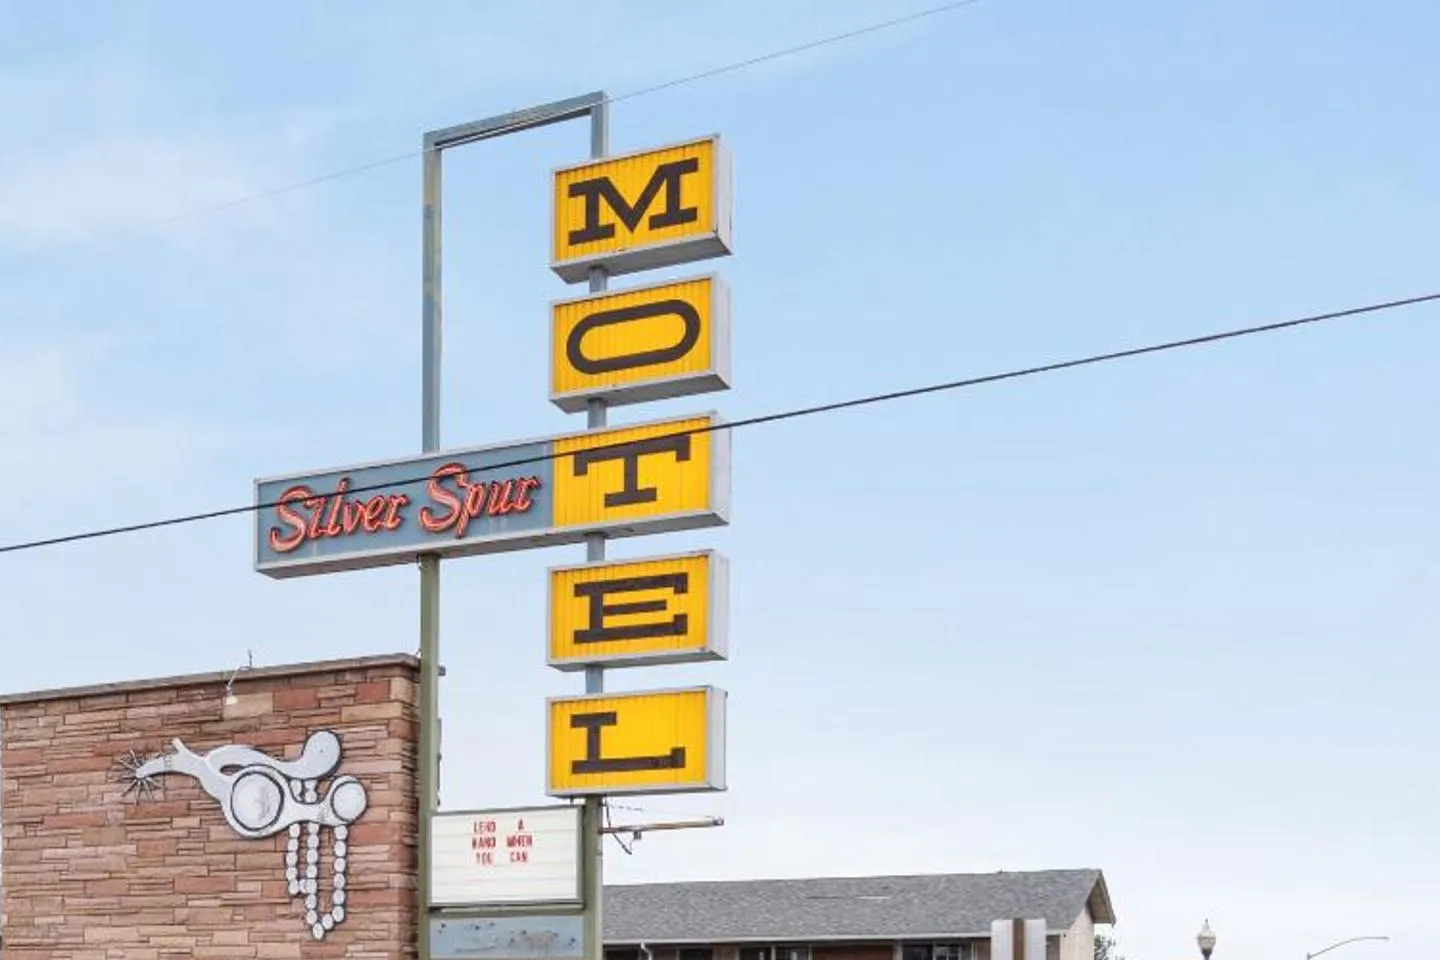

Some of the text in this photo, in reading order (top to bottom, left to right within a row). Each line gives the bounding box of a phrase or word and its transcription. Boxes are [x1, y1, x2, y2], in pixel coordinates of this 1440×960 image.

[567, 157, 701, 775] MOTEL
[270, 462, 541, 553] Silver Spur
[517, 817, 525, 830] A
[476, 851, 528, 864] YOU CAN
